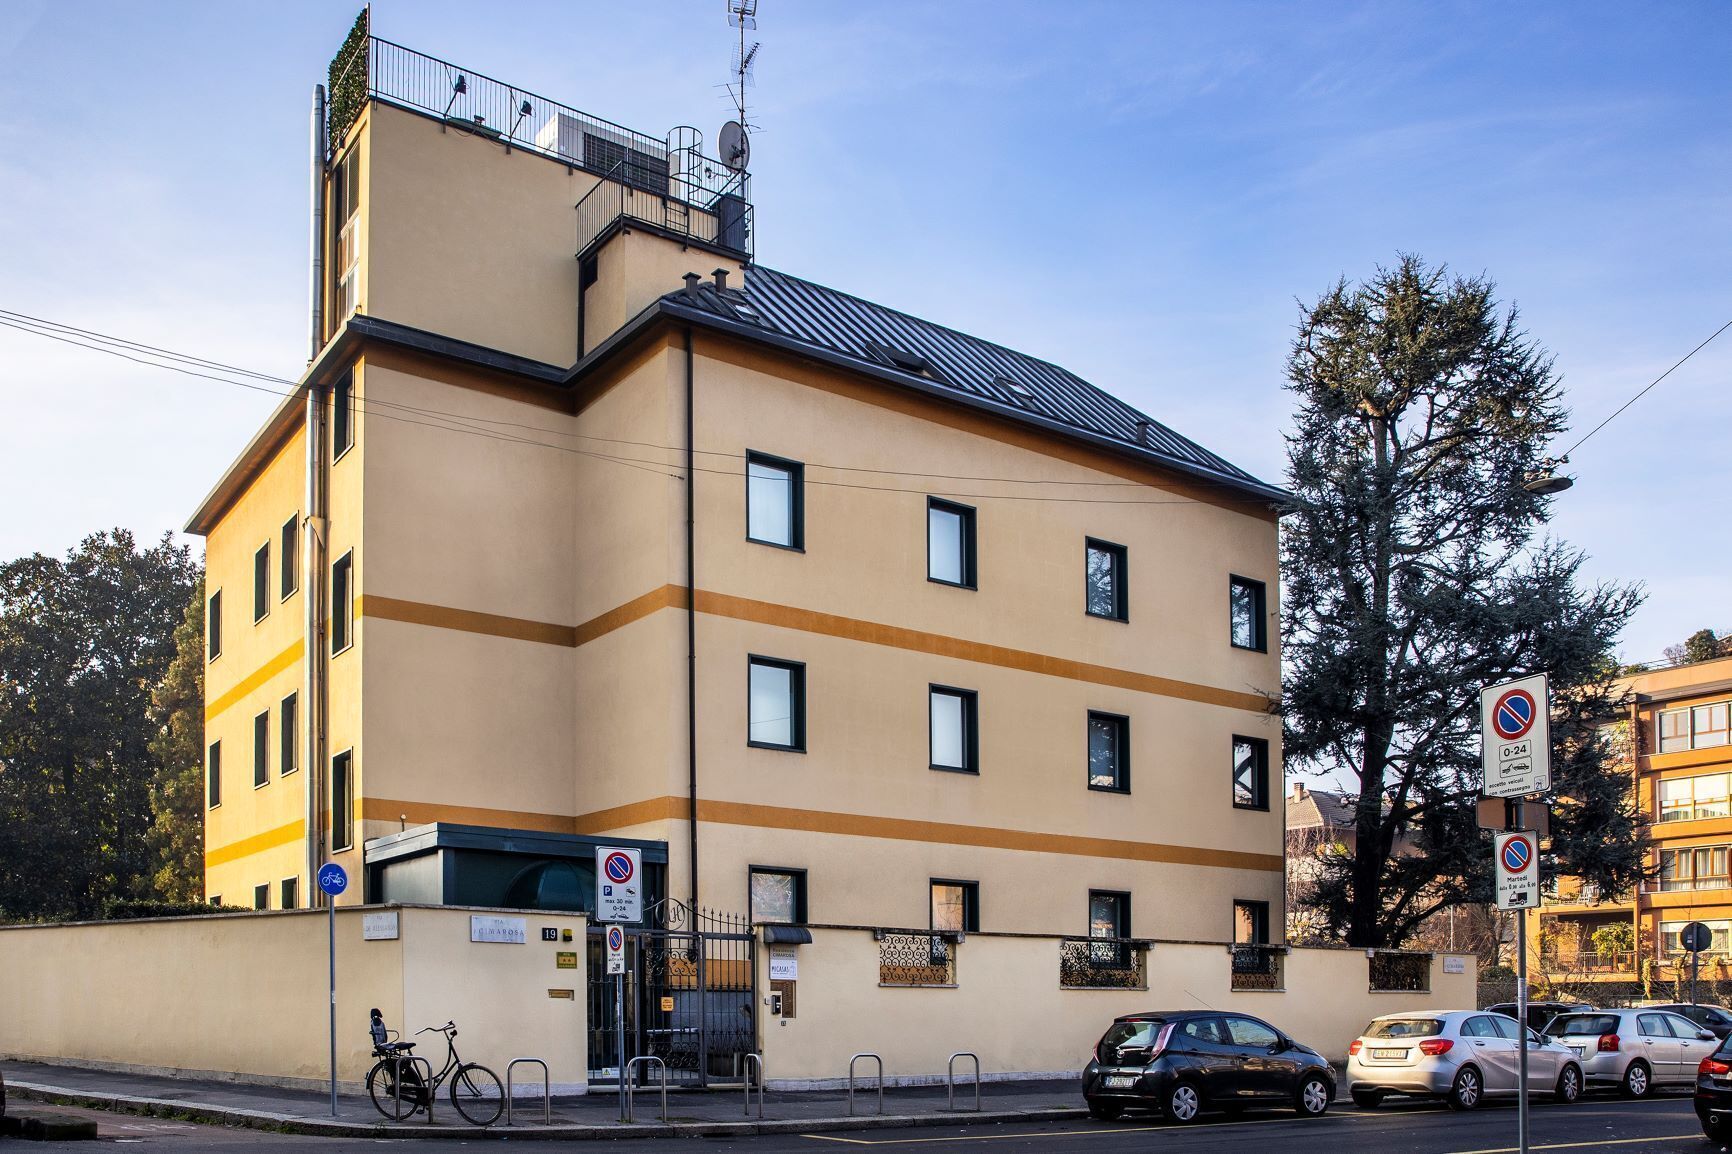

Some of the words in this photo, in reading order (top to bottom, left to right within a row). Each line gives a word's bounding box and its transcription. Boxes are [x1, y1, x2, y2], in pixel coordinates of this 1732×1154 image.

[1503, 744, 1527, 757] 0-24
[479, 928, 525, 936] CIMAROSA
[545, 929, 556, 939] 19
